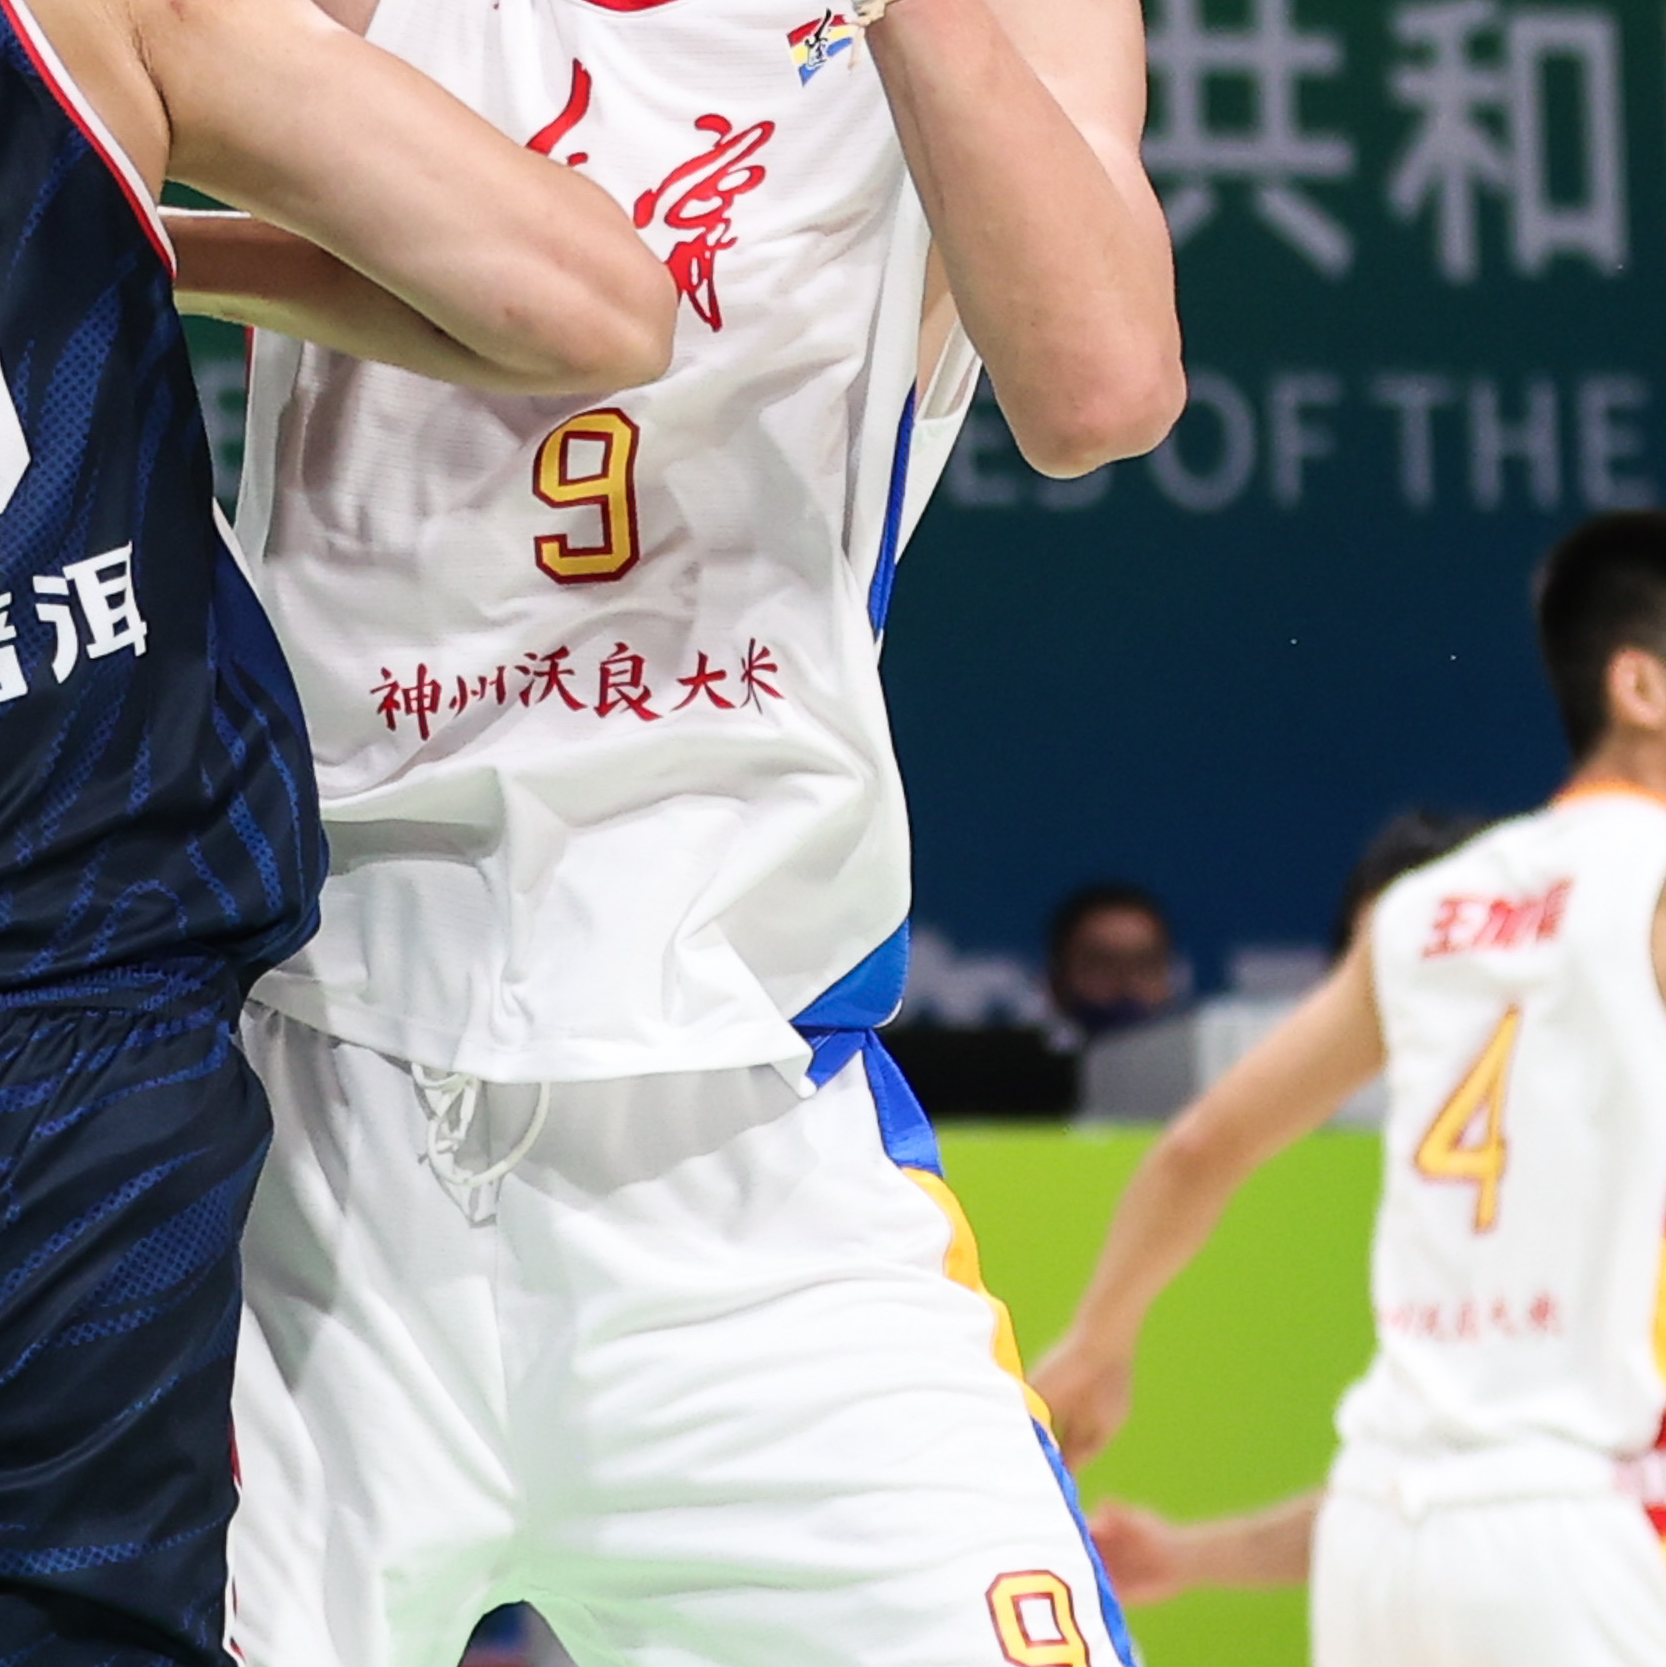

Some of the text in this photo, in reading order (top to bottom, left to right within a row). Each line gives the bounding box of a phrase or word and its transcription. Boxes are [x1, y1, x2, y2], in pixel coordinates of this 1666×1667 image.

[533, 407, 641, 585] 9
[1145, 369, 1342, 514] OF
[1368, 371, 1656, 514] THE
[370, 637, 785, 741] 神州沃良大米
[1414, 1004, 1521, 1237] 4
